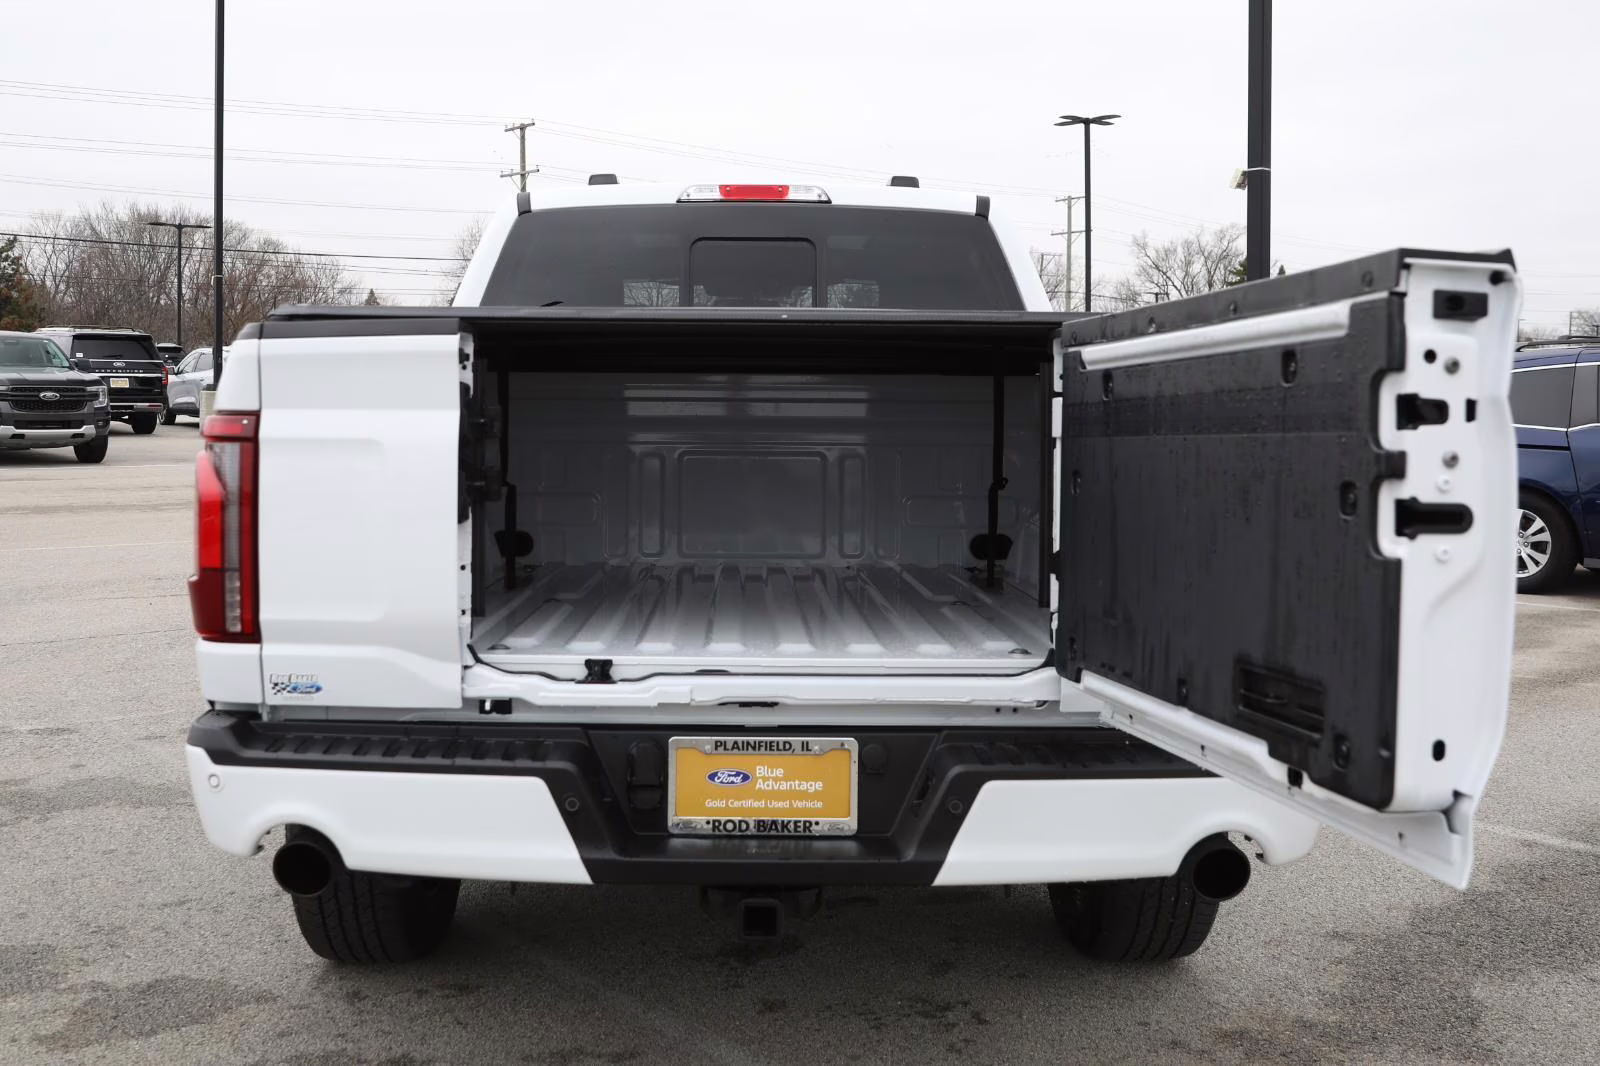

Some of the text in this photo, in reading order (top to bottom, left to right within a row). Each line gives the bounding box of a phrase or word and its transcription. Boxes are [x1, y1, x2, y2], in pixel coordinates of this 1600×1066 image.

[714, 740, 812, 754] PLAINFIELD, IL
[714, 771, 744, 783] Ford
[756, 765, 784, 777] Blue
[756, 778, 824, 793] Advantage
[705, 799, 824, 809] Gold Certified Used Vehicle
[711, 818, 751, 833] ROD
[756, 819, 813, 834] BAKER
